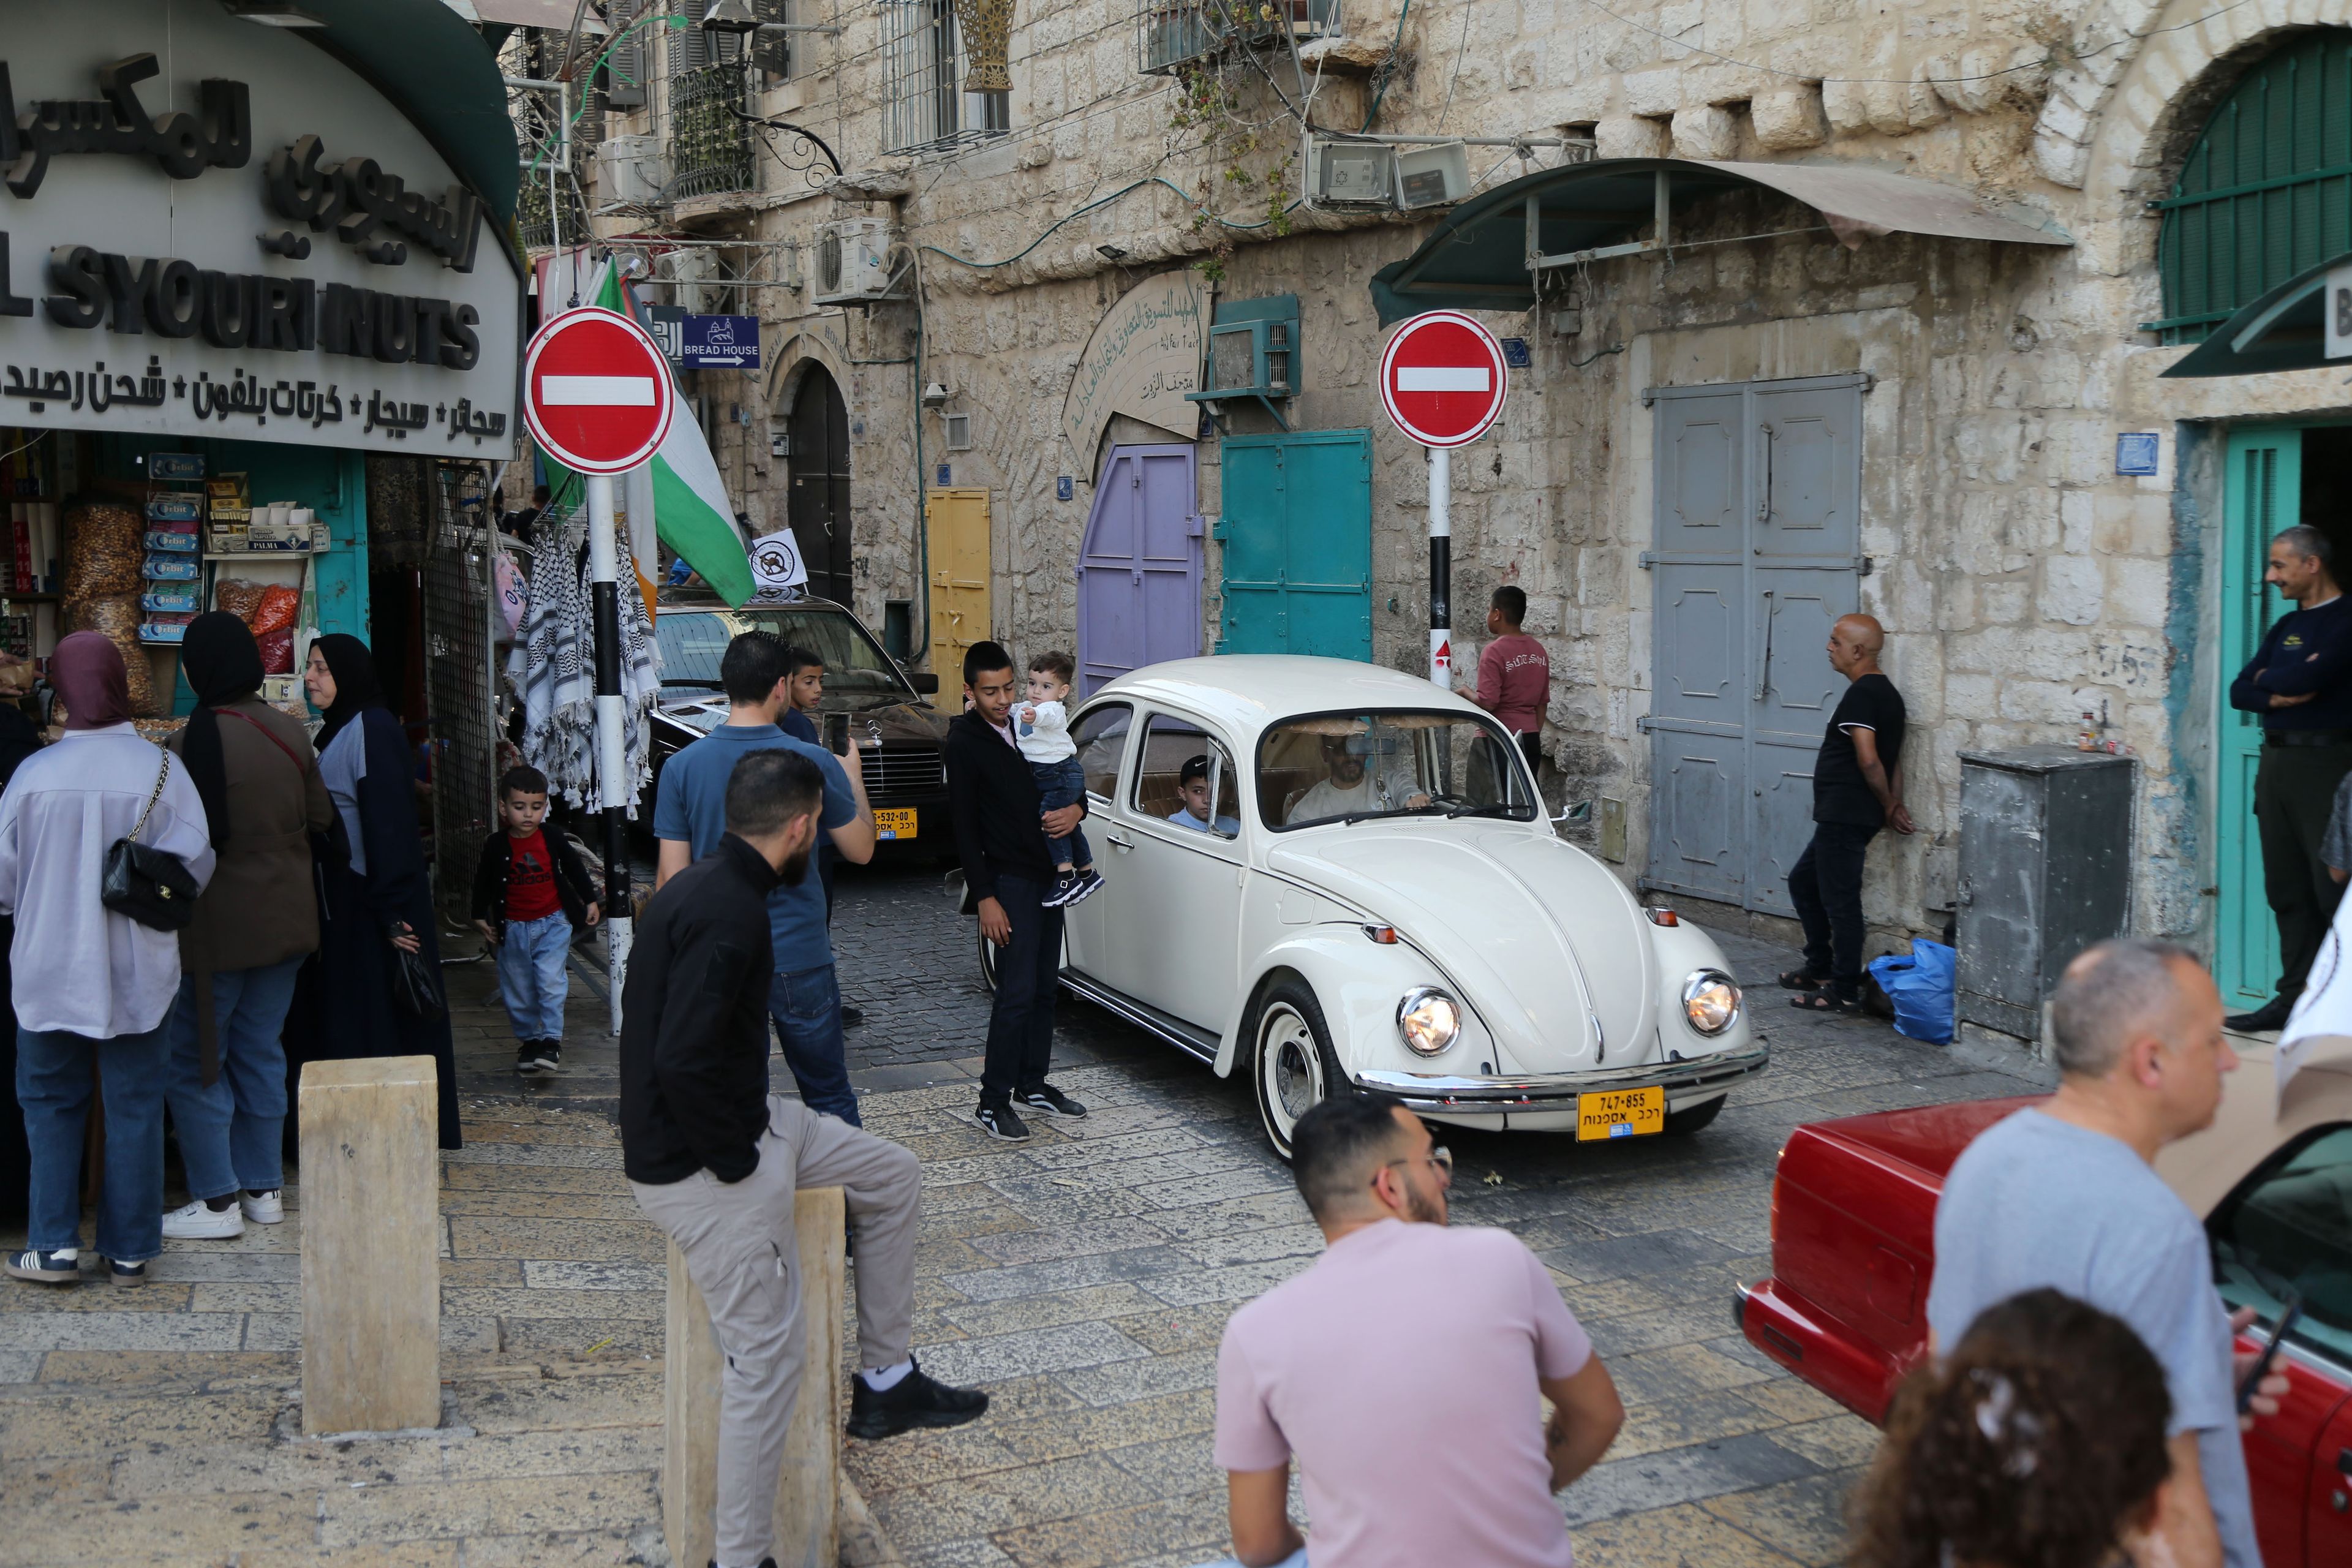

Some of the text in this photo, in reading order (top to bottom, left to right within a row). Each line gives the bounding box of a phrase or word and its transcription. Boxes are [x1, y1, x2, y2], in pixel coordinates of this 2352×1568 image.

[0, 53, 252, 199] للمكسرا
[47, 244, 315, 352] SYOURI
[325, 282, 480, 371] NUTS
[2337, 288, 2352, 336] B
[685, 345, 758, 355] BREAD HOUSE
[89, 355, 166, 413] شحن
[158, 503, 187, 514] Orbit
[158, 535, 186, 546] Orbit
[156, 564, 184, 573] Orbit
[155, 596, 183, 605] Orbit
[153, 625, 181, 635] Orbit
[1583, 1109, 1659, 1125] רכב אספנות
